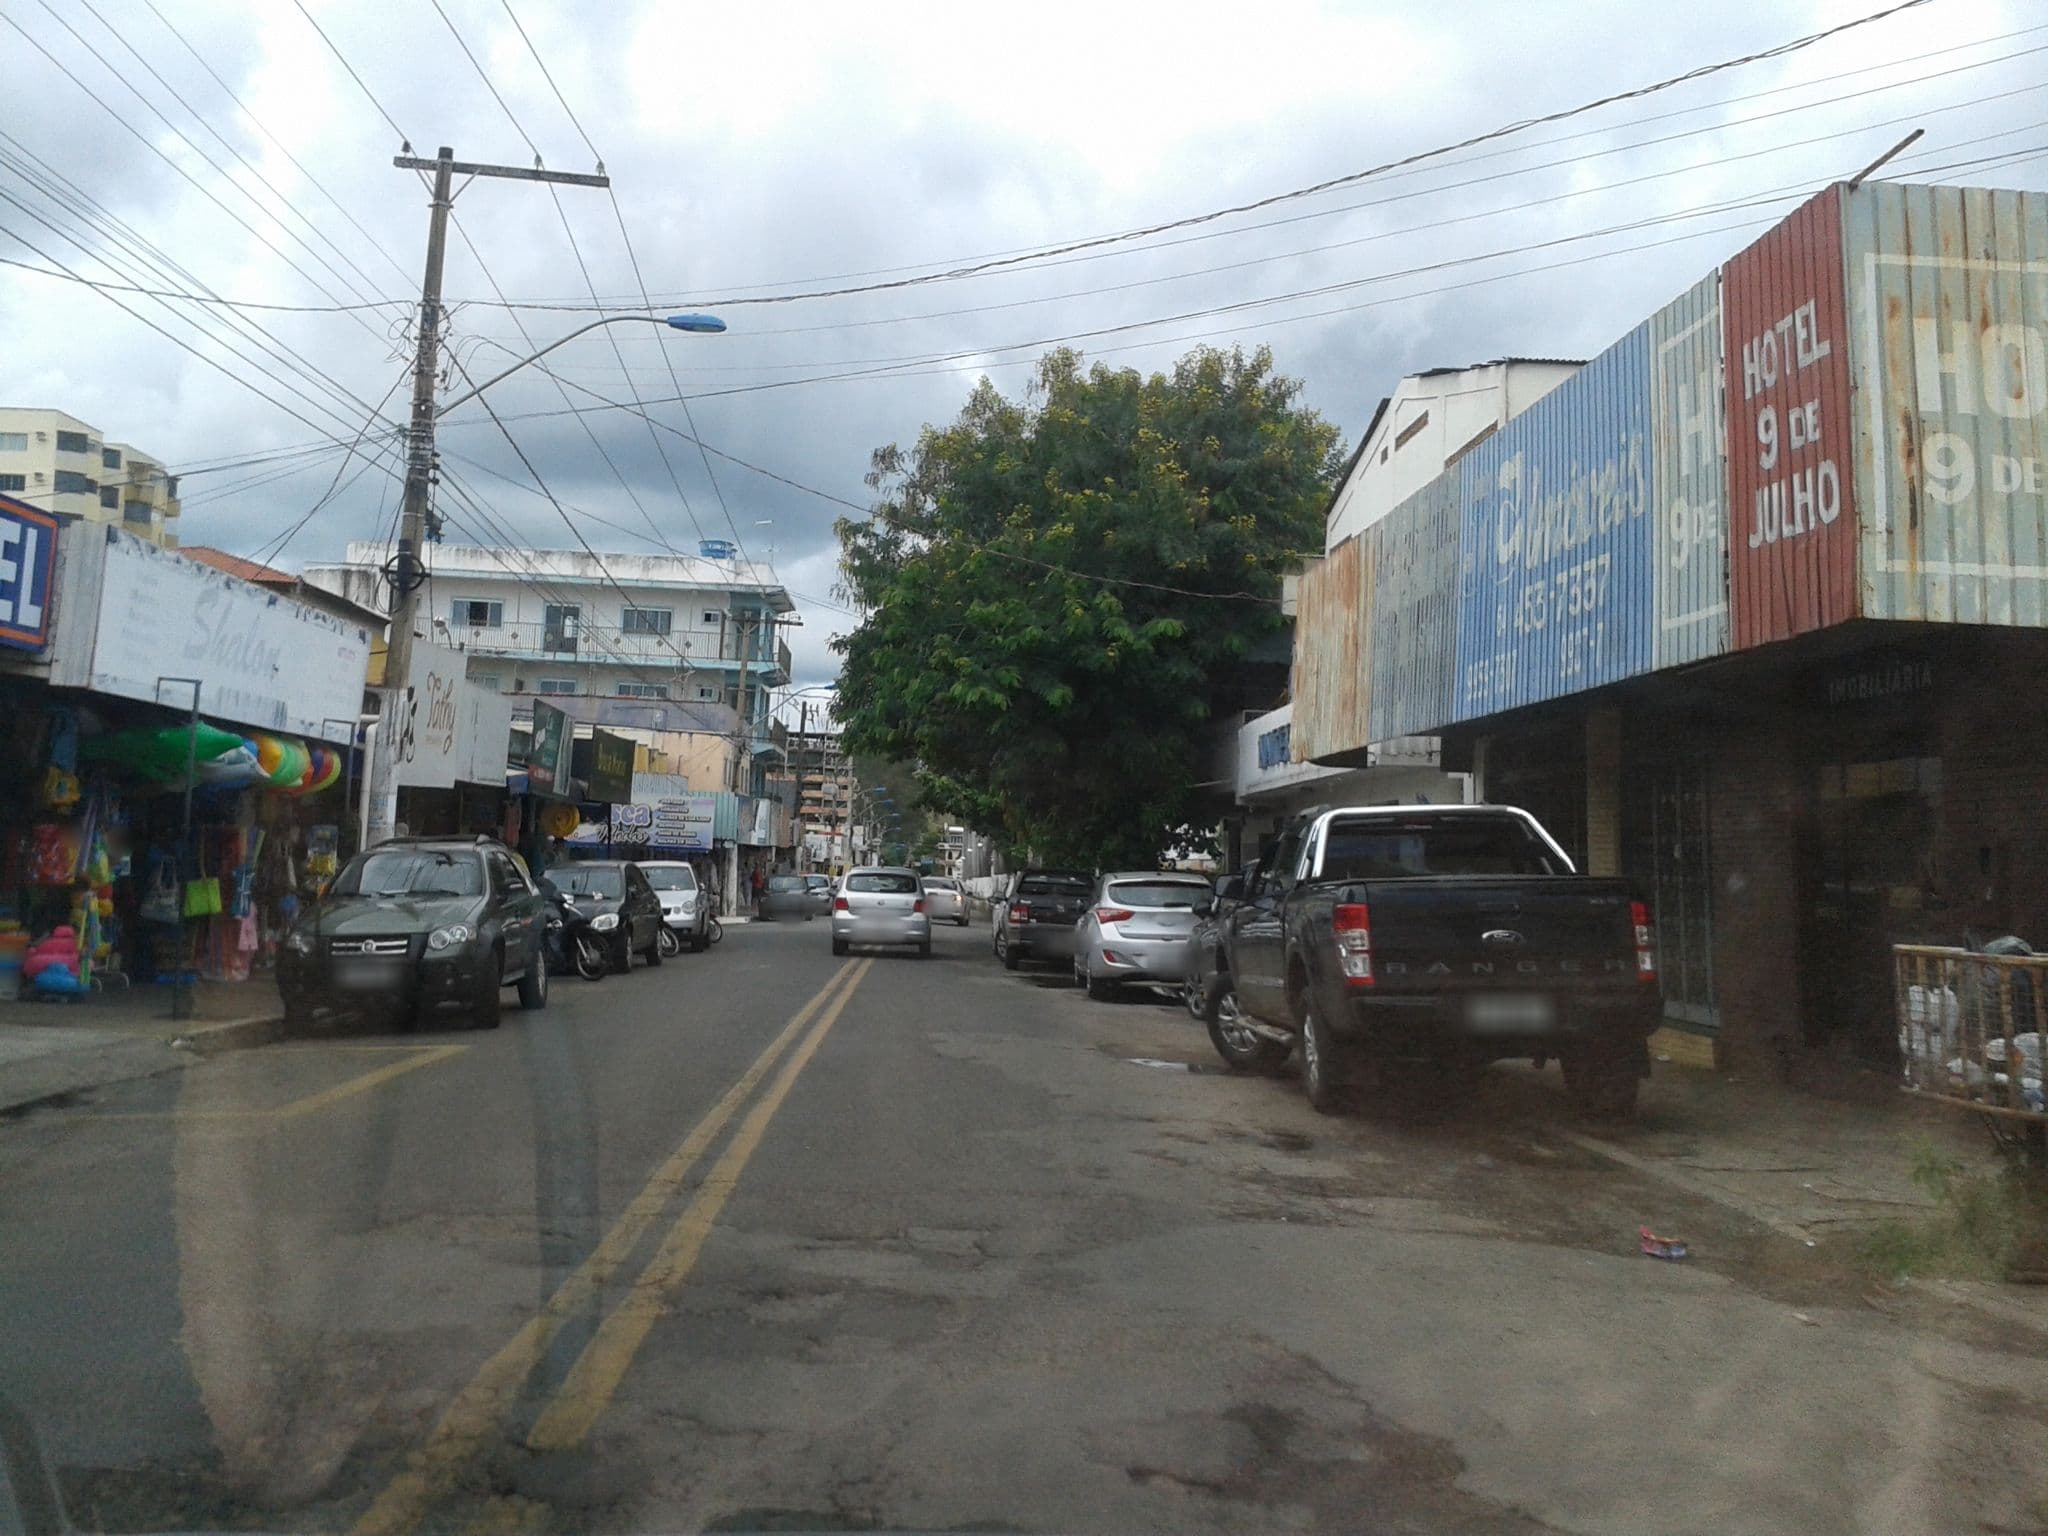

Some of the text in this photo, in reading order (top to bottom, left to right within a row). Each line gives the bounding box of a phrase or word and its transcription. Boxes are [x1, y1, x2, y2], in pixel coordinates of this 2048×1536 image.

[1743, 298, 1831, 401] HOTEL
[1757, 398, 1821, 470] 9 DE
[1922, 431, 1976, 505] 9
[1670, 496, 1718, 570] 9 DE
[1748, 457, 1841, 548] JULHO
